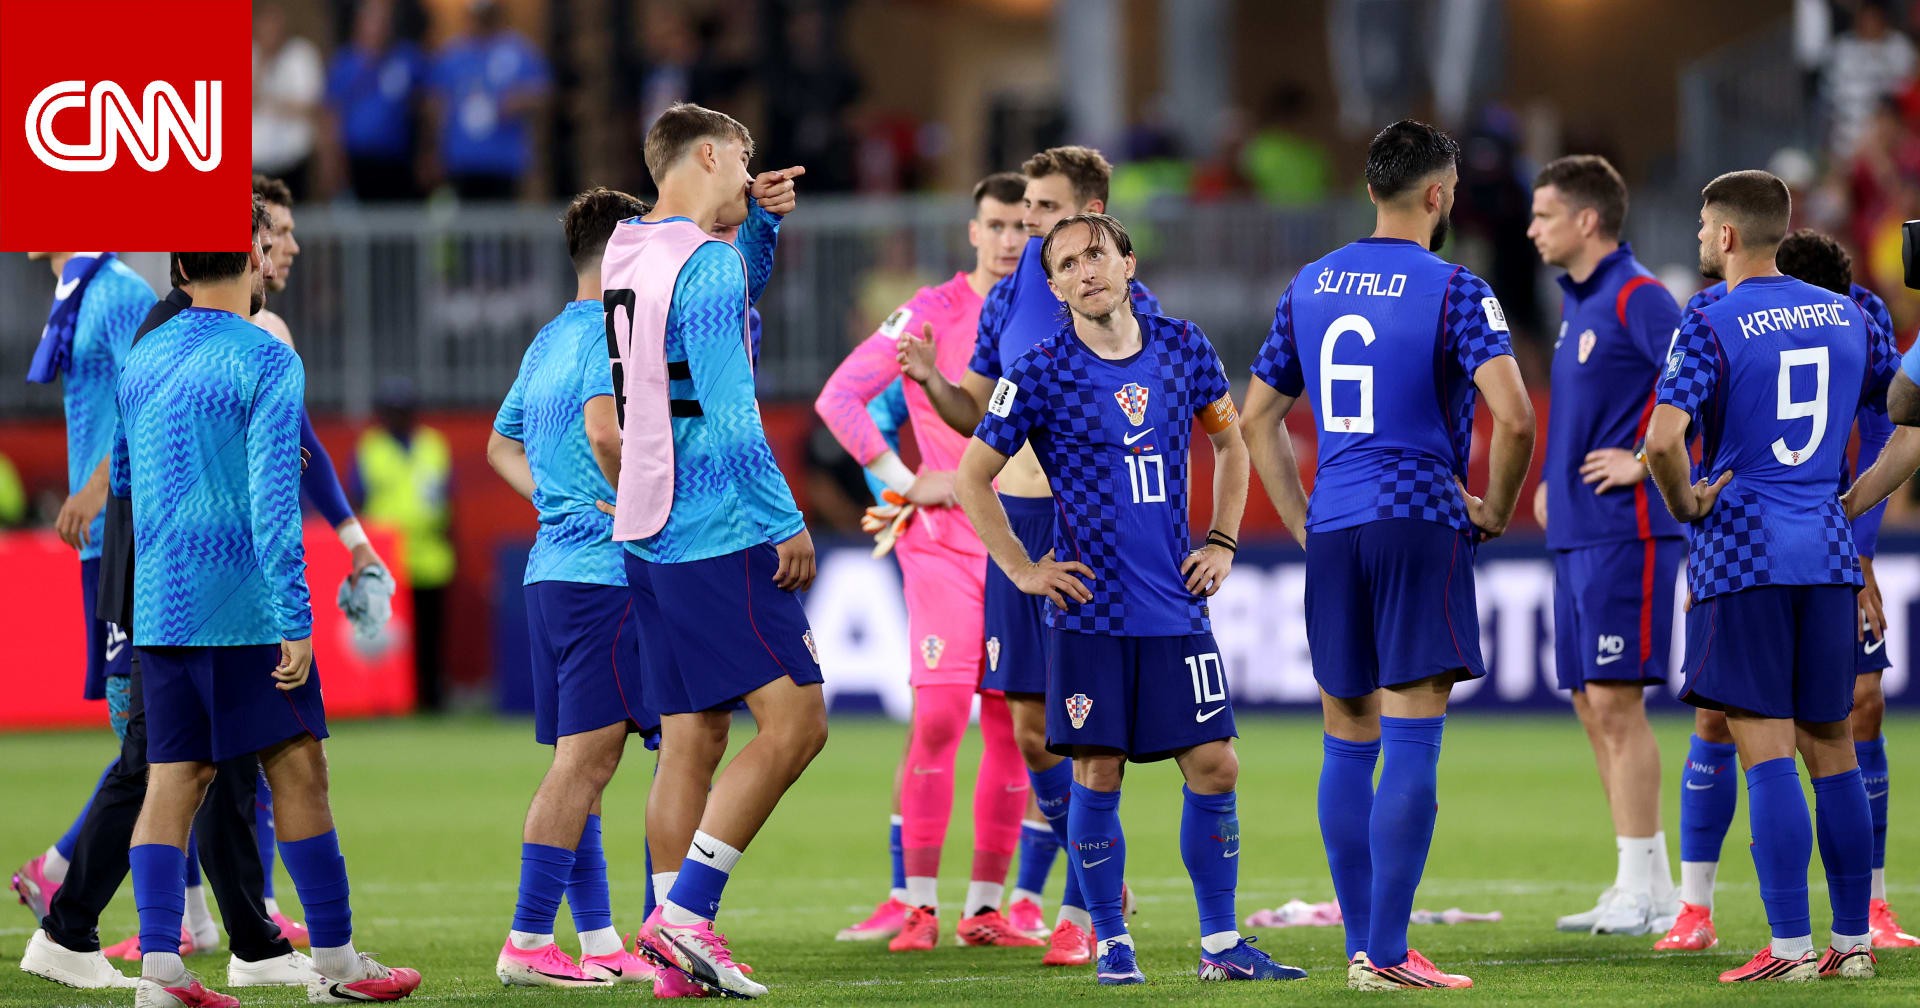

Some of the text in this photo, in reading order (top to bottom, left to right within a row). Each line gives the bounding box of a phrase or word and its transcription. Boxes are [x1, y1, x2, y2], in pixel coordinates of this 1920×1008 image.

[1320, 314, 1376, 433] 6
[1771, 346, 1829, 466] 9
[1124, 454, 1166, 503] 10
[1598, 634, 1625, 654] MD
[1185, 653, 1226, 704] 10
[1080, 840, 1109, 851] HNS
